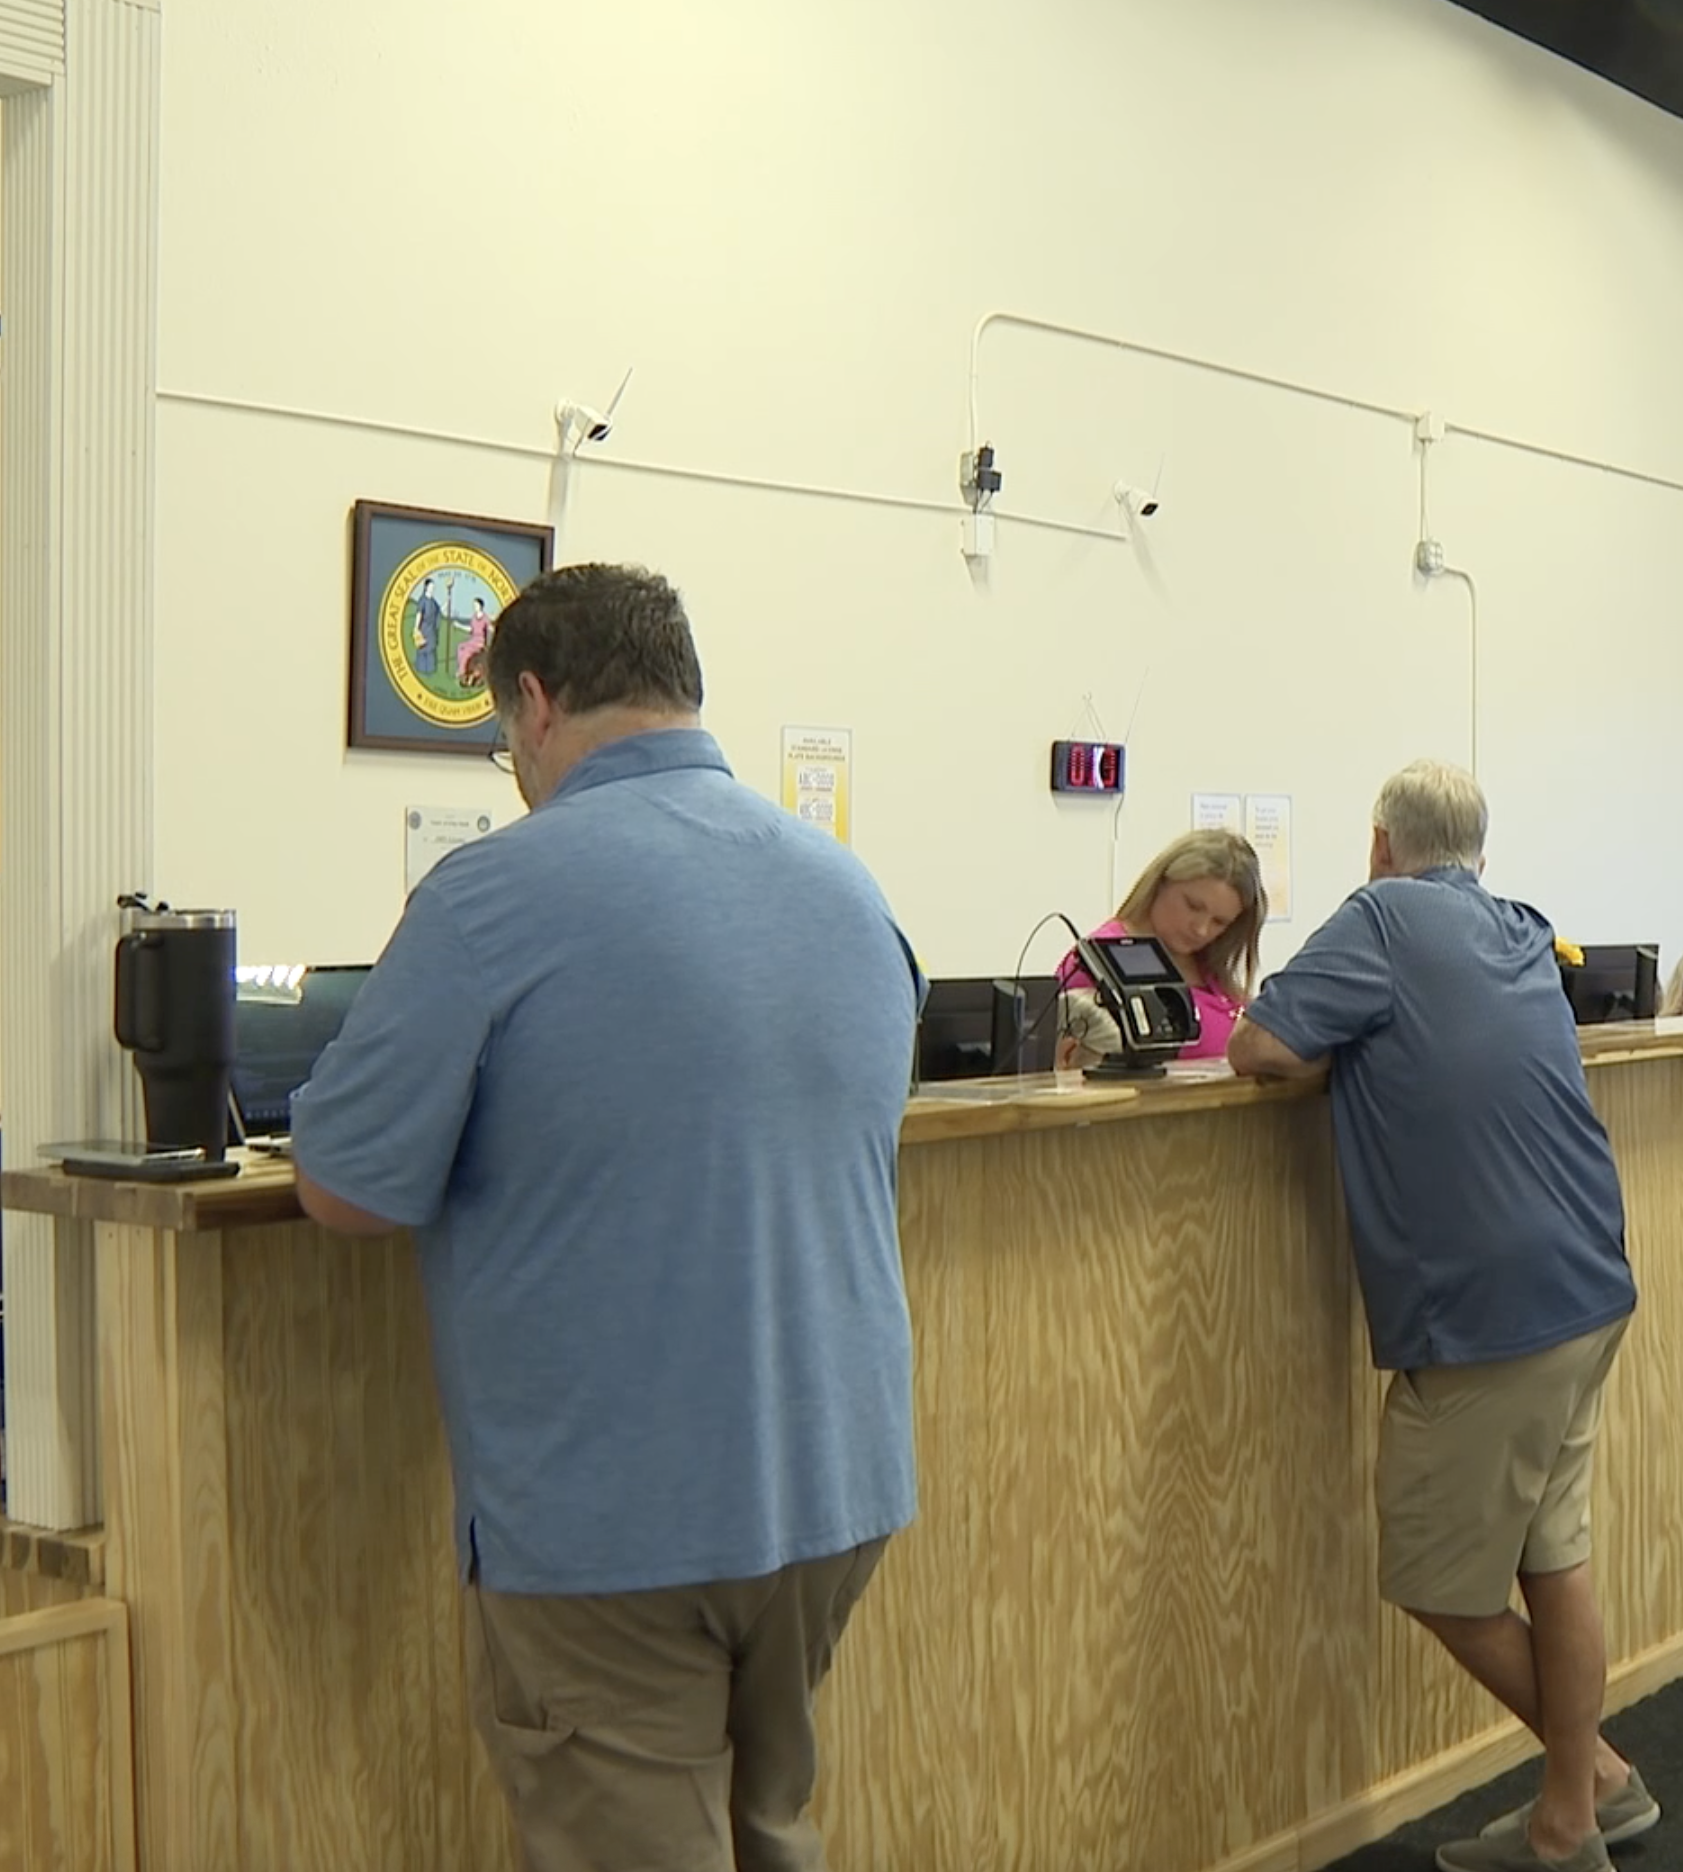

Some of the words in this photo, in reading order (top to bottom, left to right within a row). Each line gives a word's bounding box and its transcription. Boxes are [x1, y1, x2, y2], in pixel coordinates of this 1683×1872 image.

[443, 550, 475, 567] STATE
[395, 571, 416, 598] SEAL
[488, 569, 513, 603] NORT
[387, 603, 400, 650] GREAT
[391, 655, 408, 682] THE
